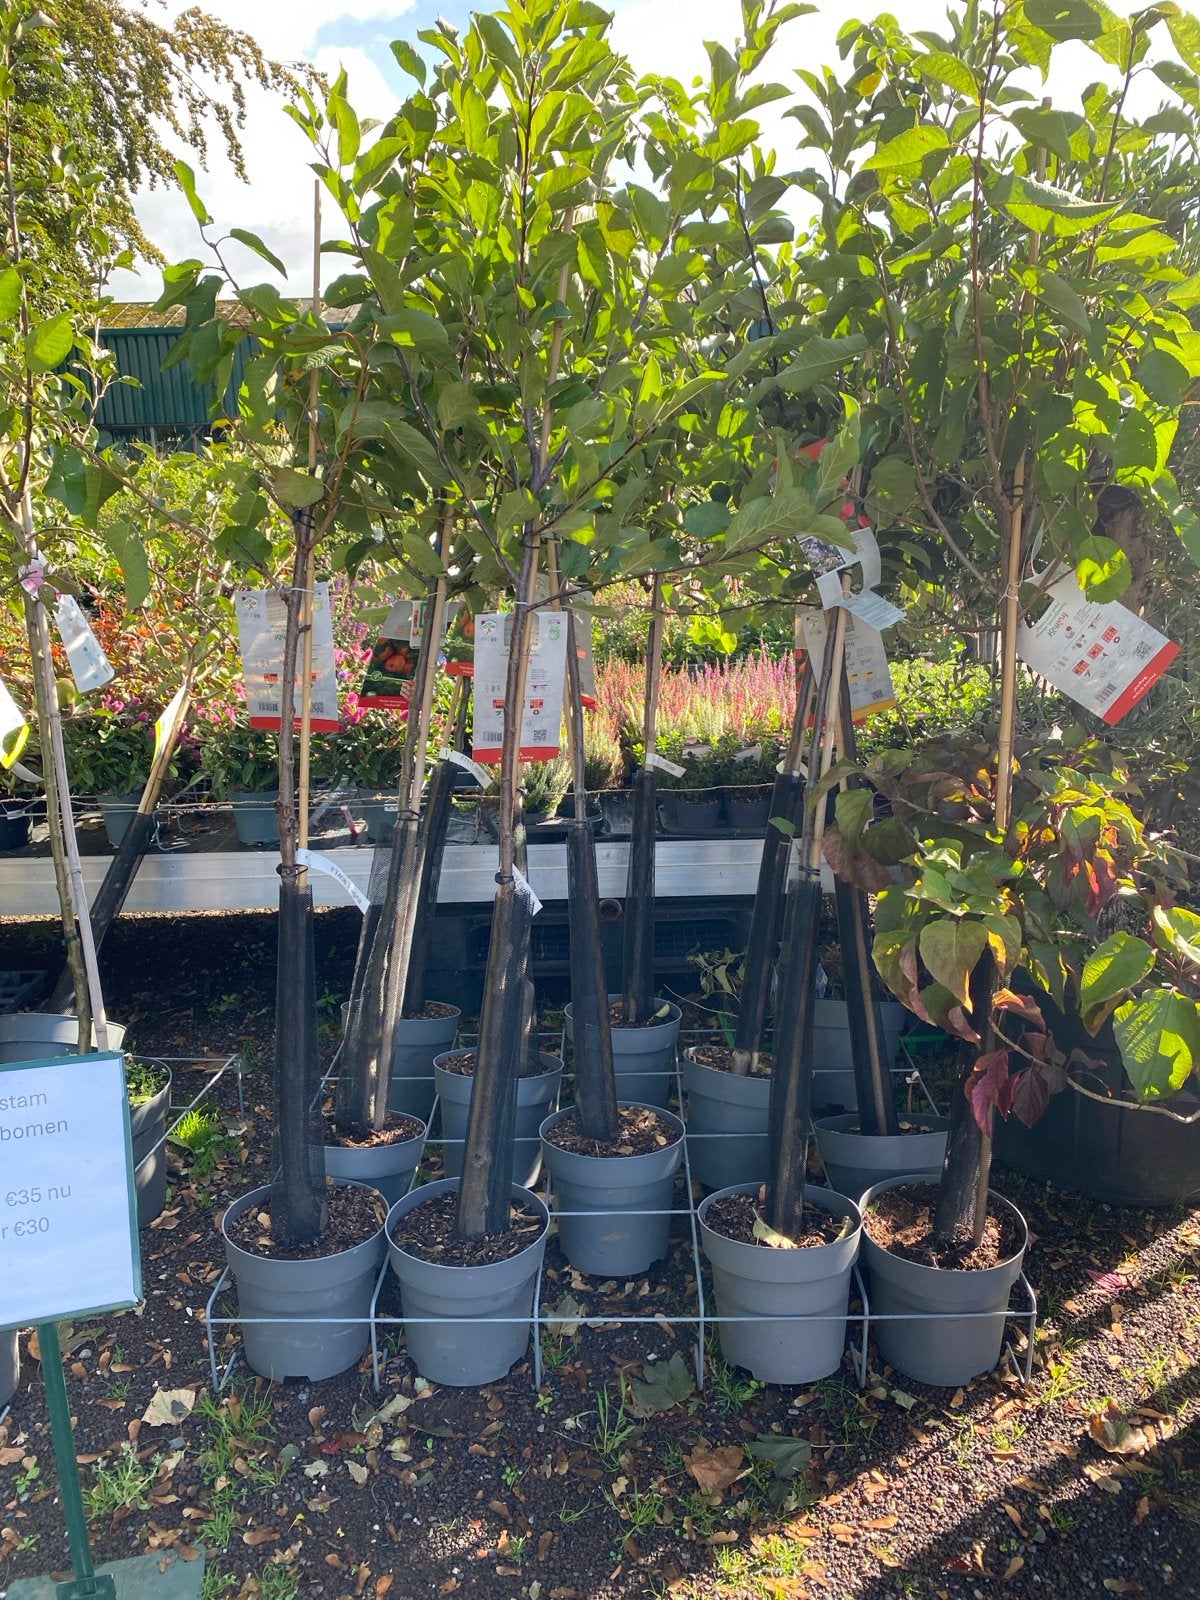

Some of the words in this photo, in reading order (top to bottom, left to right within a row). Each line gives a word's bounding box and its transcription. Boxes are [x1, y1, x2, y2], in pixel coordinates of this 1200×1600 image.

[0, 1093, 47, 1111] stam
[0, 1120, 68, 1141] bomen
[6, 1187, 42, 1207] €35
[48, 1185, 72, 1201] nu
[13, 1217, 49, 1236] €30
